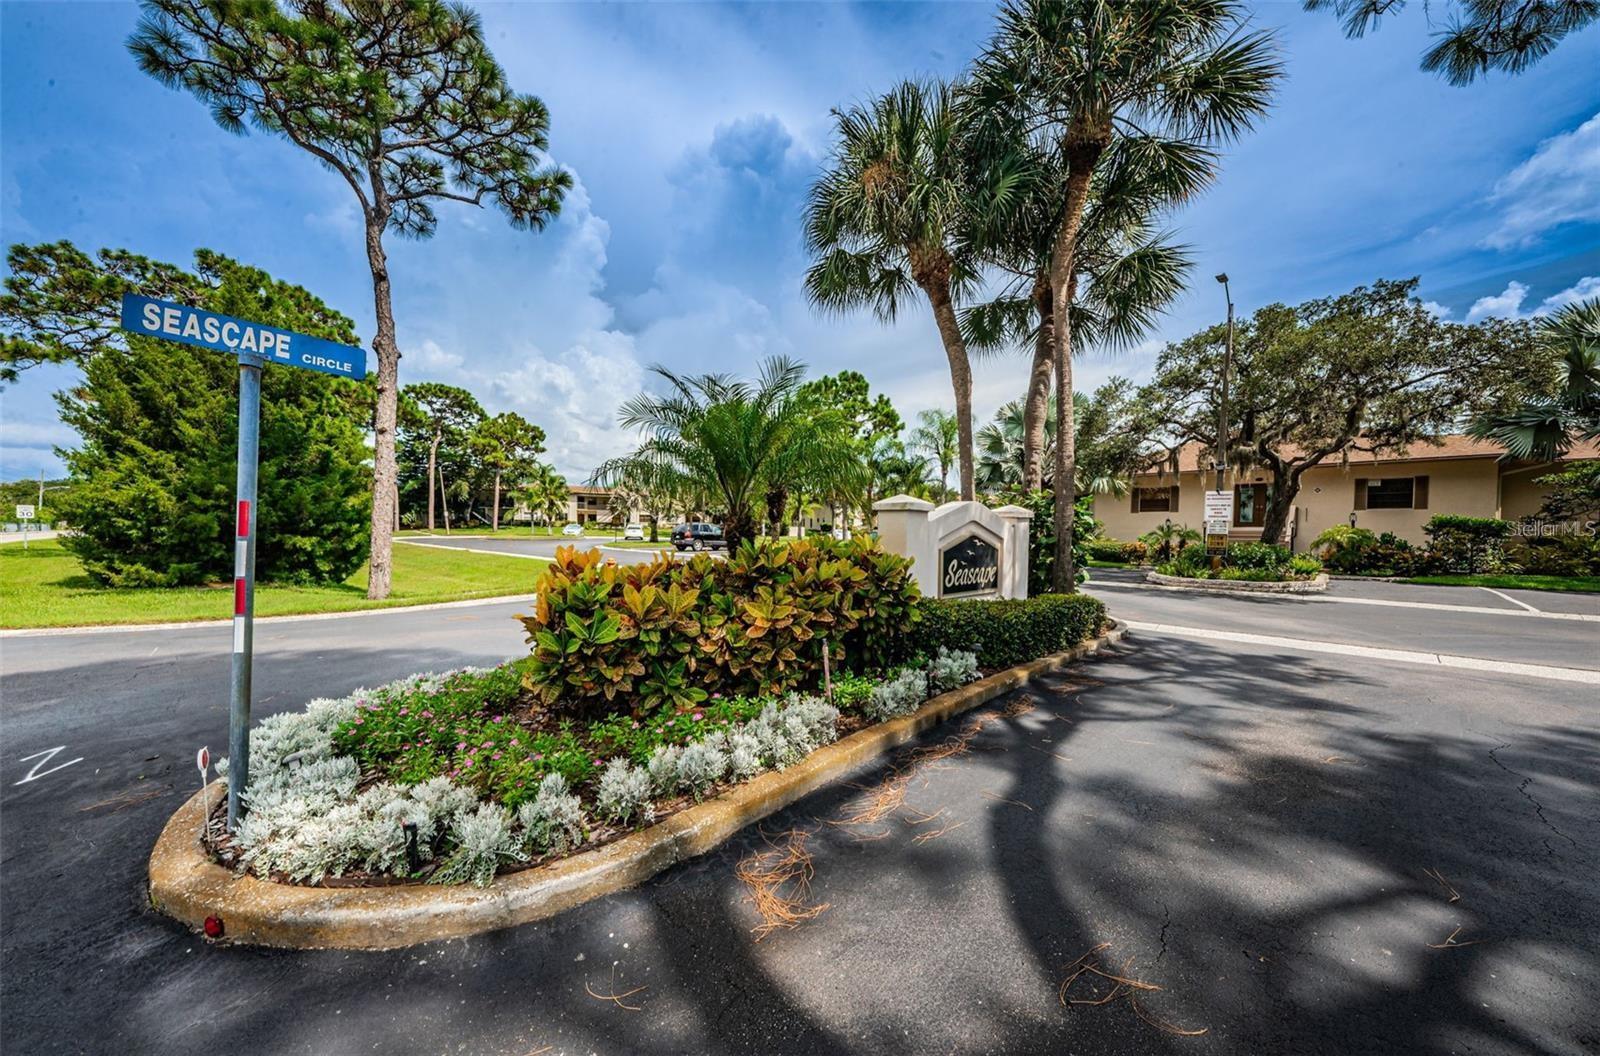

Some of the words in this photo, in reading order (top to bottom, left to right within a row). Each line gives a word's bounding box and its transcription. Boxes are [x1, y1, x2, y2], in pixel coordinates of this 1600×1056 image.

[142, 303, 291, 359] SEASCAPE
[302, 353, 352, 373] CIRCLE
[945, 559, 997, 588] Seascape
